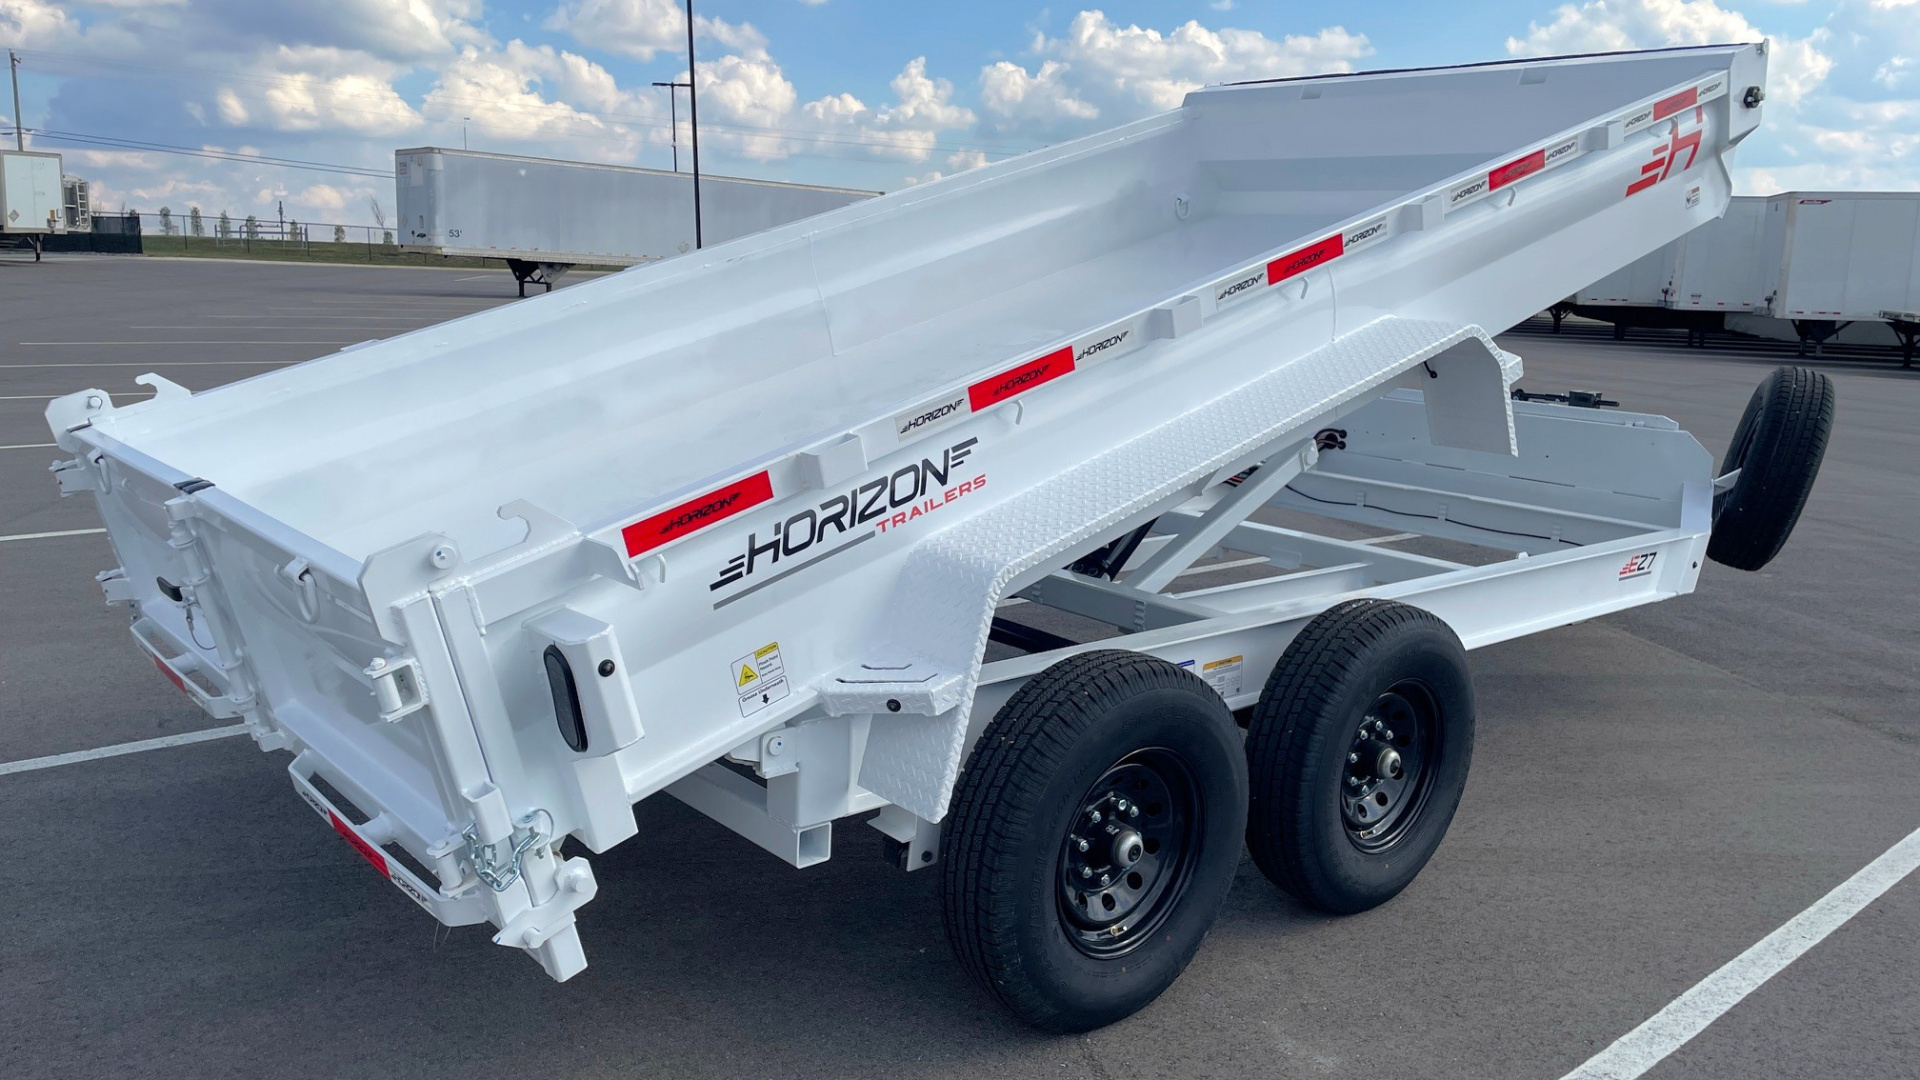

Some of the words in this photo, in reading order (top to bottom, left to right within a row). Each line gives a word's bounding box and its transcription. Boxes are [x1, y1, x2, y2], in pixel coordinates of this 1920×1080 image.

[1455, 181, 1485, 201] HORIZON
[1347, 225, 1381, 246] HORIZON
[1221, 274, 1262, 299] HORIZON
[1079, 332, 1126, 359] HORIZON
[997, 365, 1048, 394] HORIZON
[905, 400, 961, 432] HORIZON
[666, 494, 737, 532] HORIZON
[727, 443, 964, 583] HORIZON
[876, 474, 987, 533] TRAILERS
[1626, 552, 1658, 573] E27
